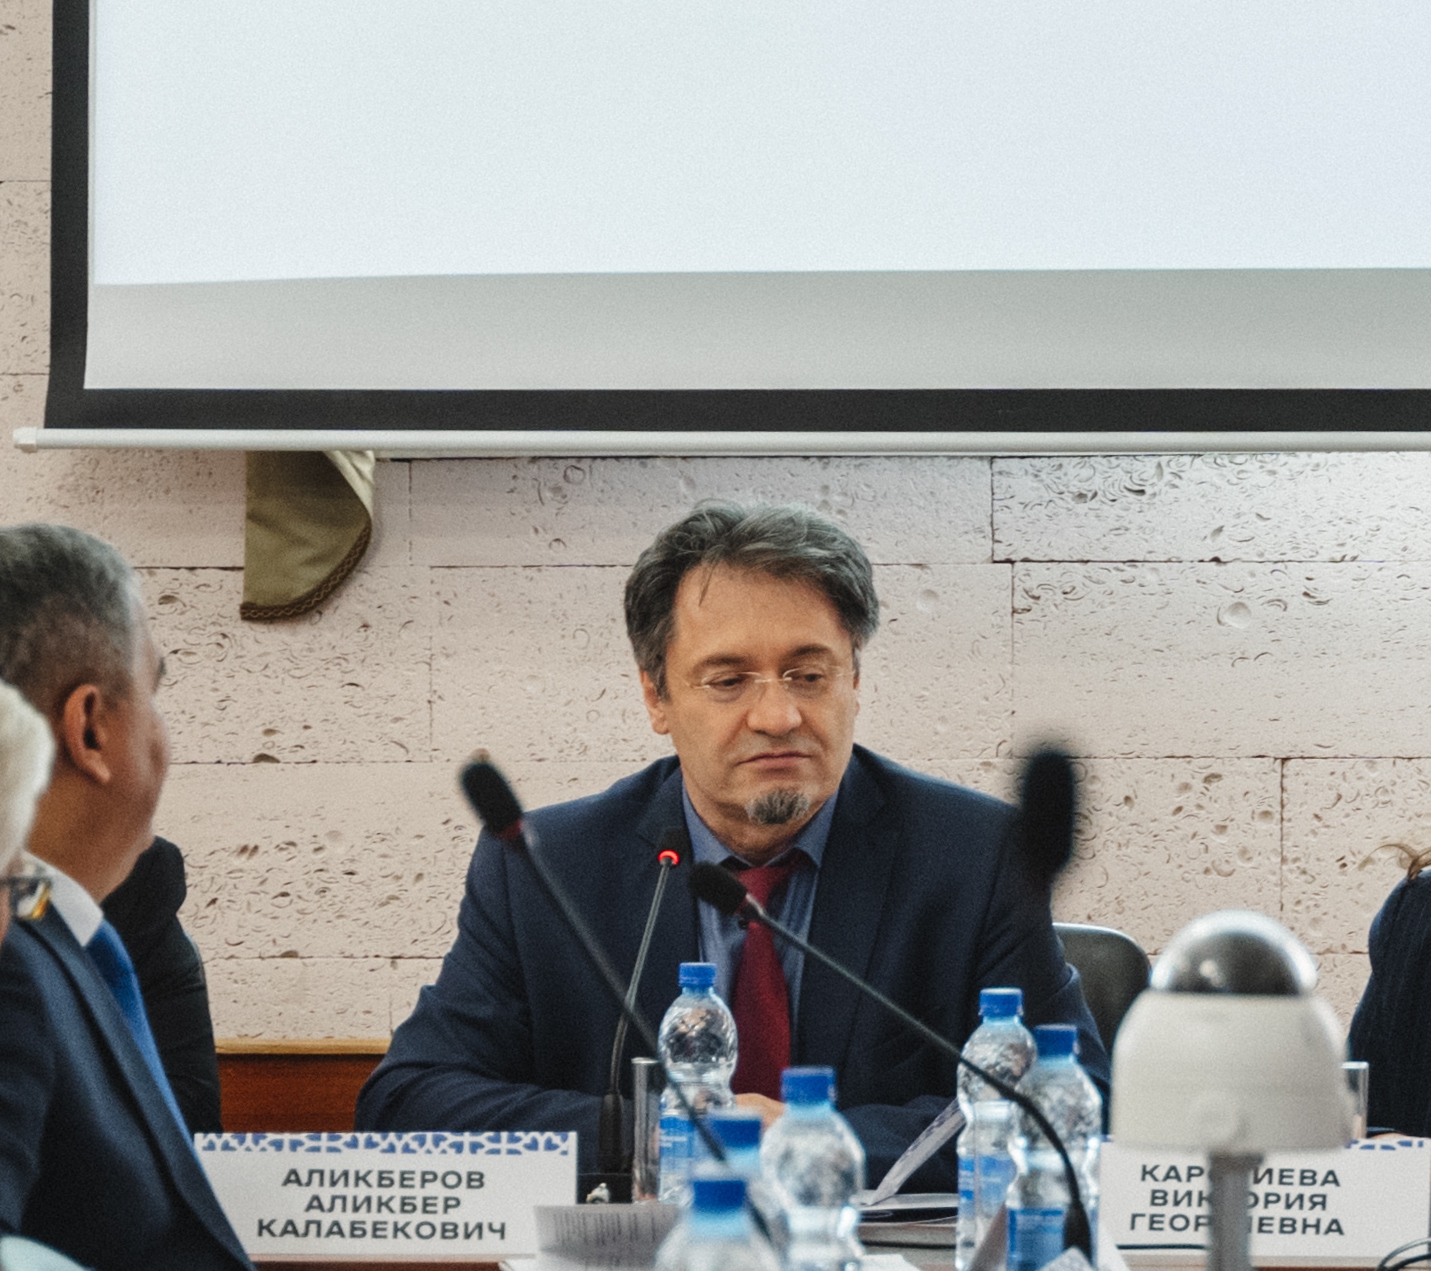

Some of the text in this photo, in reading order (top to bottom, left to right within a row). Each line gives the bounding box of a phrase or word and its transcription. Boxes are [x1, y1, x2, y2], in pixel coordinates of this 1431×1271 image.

[280, 1167, 486, 1191] АЛИКБЕРОВ
[1140, 1163, 1341, 1187] КАРИЕВА
[303, 1193, 463, 1216] АЛИКБЕР
[1149, 1189, 1328, 1211] ВИКОРИЯ
[255, 1217, 507, 1242] КАЛАБЕКОВИЧ
[1129, 1213, 1345, 1236] ГЕОРЕВНА
